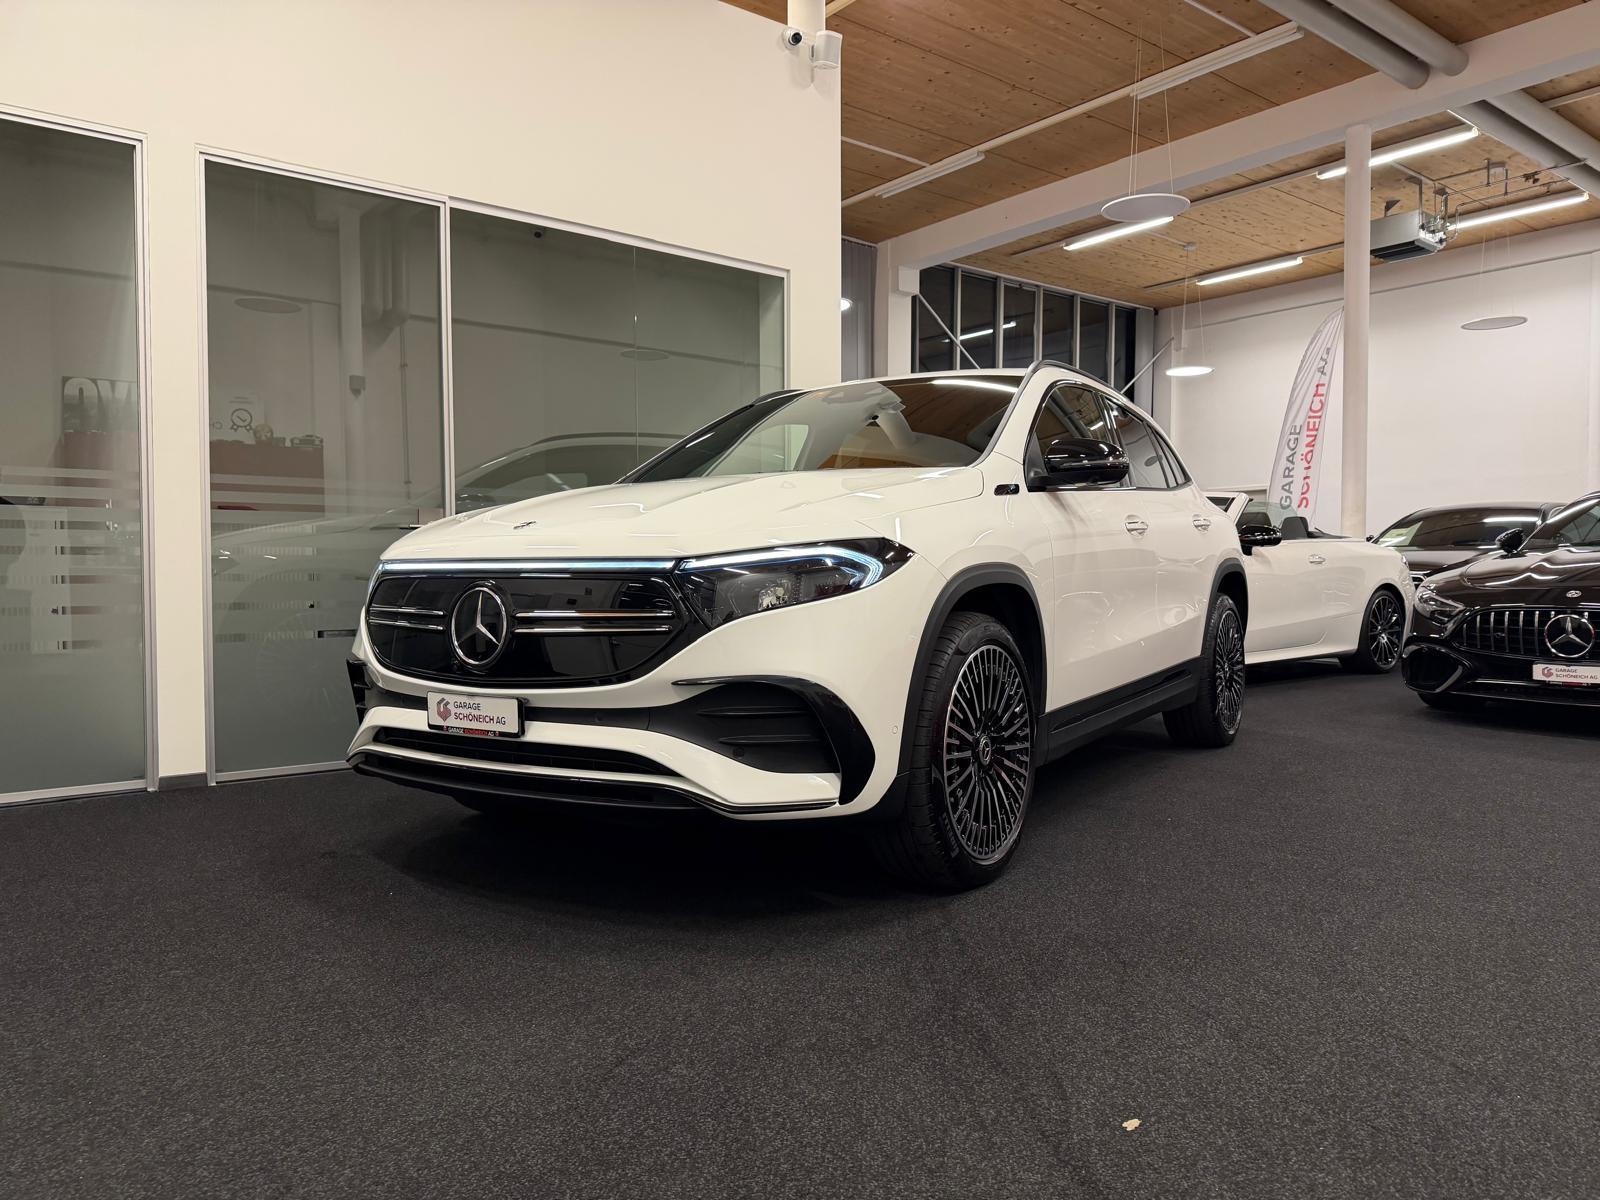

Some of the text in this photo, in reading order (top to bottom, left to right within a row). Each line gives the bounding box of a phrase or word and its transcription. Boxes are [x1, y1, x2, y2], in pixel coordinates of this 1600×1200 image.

[1280, 424, 1302, 510] GARAGE
[453, 701, 481, 711] GARAGE
[453, 712, 506, 726] SCHÖNEICH AG
